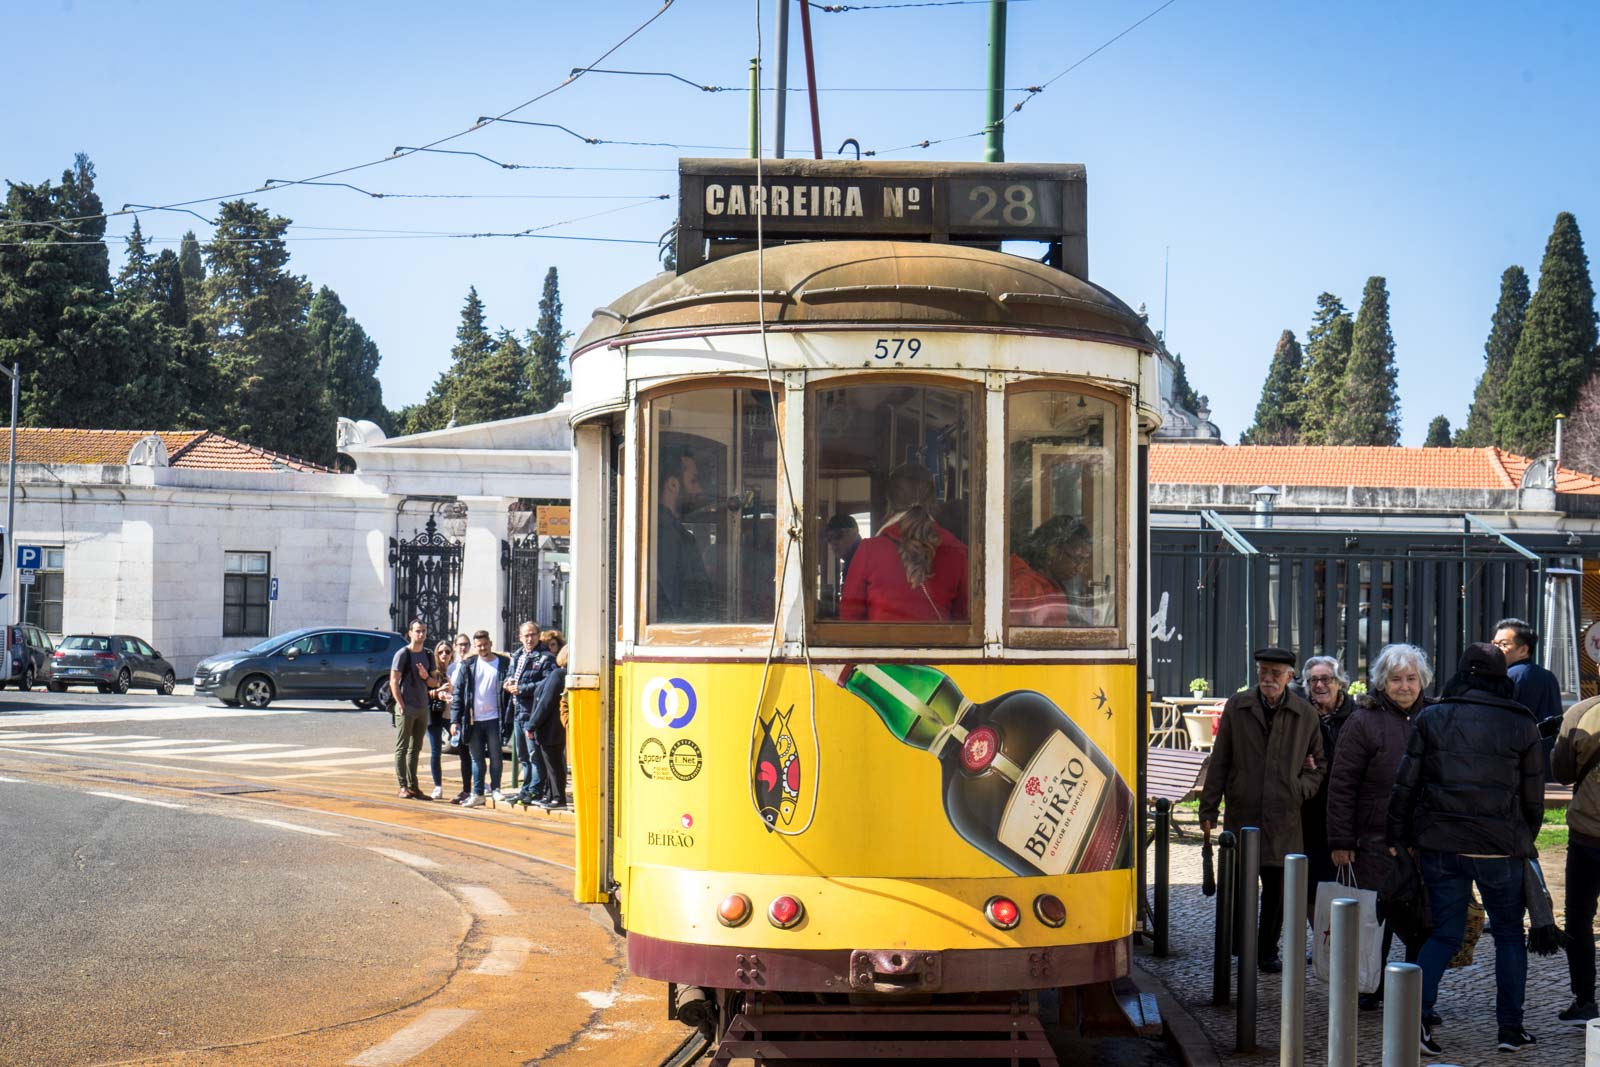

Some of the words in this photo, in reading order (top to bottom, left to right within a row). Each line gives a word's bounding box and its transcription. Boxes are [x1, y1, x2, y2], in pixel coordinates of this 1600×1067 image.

[705, 184, 864, 217] CARREIRA
[968, 185, 1035, 227] 28
[874, 338, 922, 360] 579
[22, 549, 36, 566] P
[1024, 757, 1084, 859] BEIRÃO
[1034, 776, 1059, 820] LICOR
[1053, 827, 1067, 850] LICOR
[1064, 817, 1071, 828] DE
[1069, 779, 1089, 816] PORTUGAL
[648, 832, 694, 848] BEIRÃO
